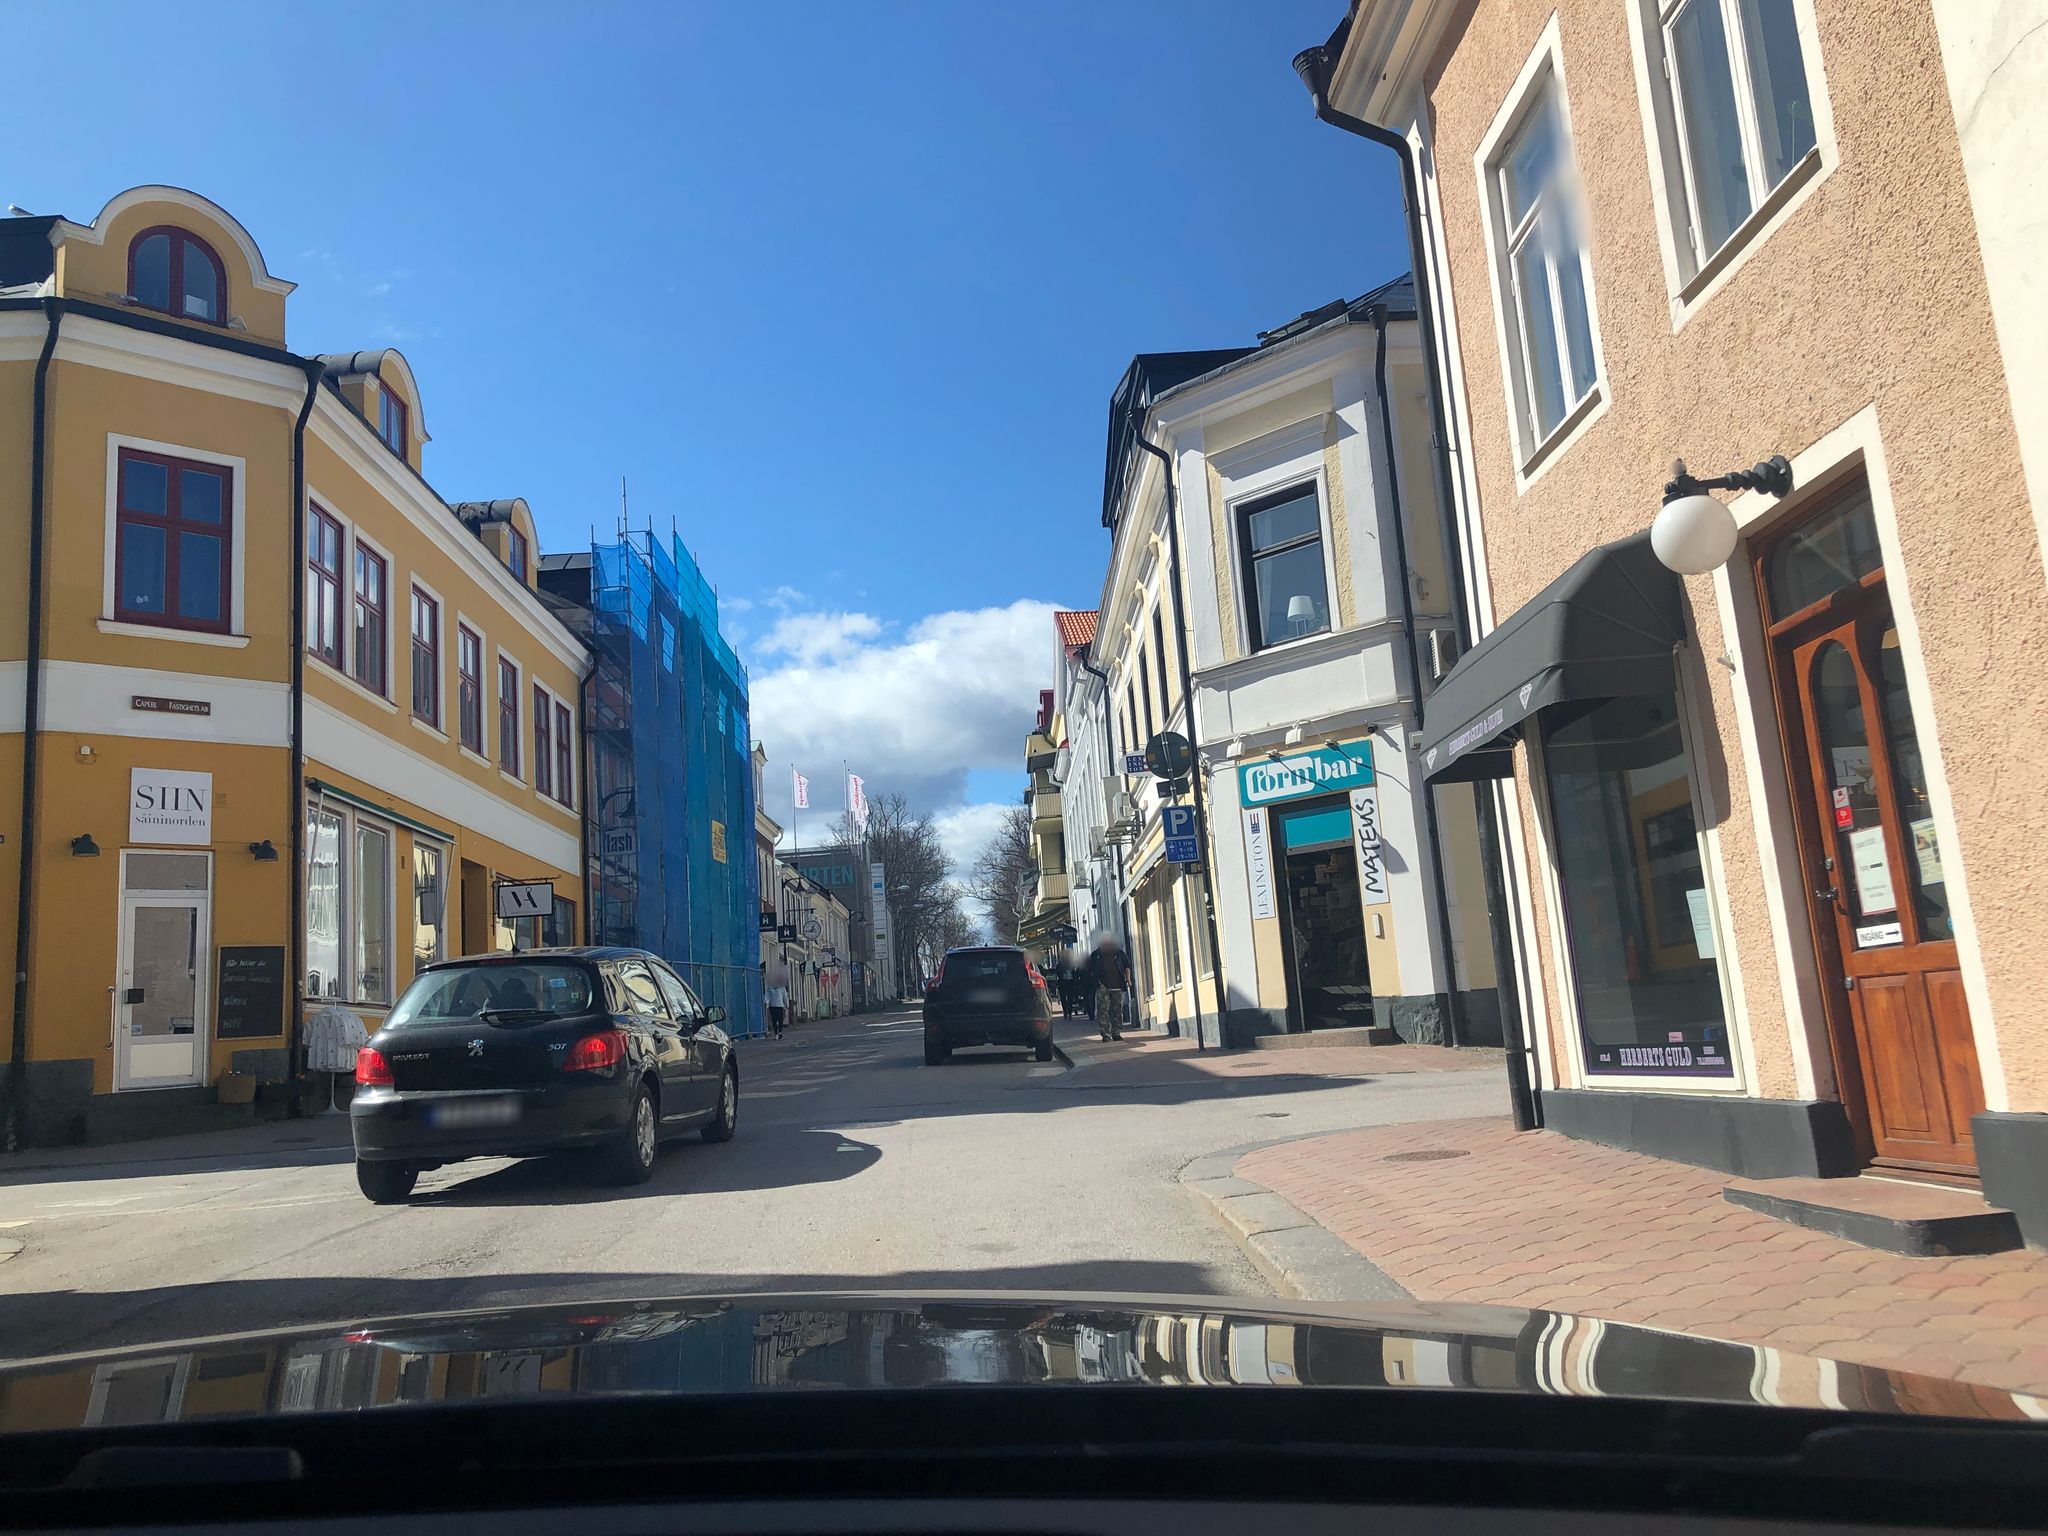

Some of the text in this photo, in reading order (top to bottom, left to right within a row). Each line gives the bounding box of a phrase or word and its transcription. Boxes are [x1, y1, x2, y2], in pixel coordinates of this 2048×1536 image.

[135, 784, 207, 812] SIIN
[1169, 809, 1188, 835] P
[1252, 835, 1269, 916] LEXINGTON
[1860, 930, 1884, 942] INGÅNG
[1665, 1047, 1692, 1067] GULD
